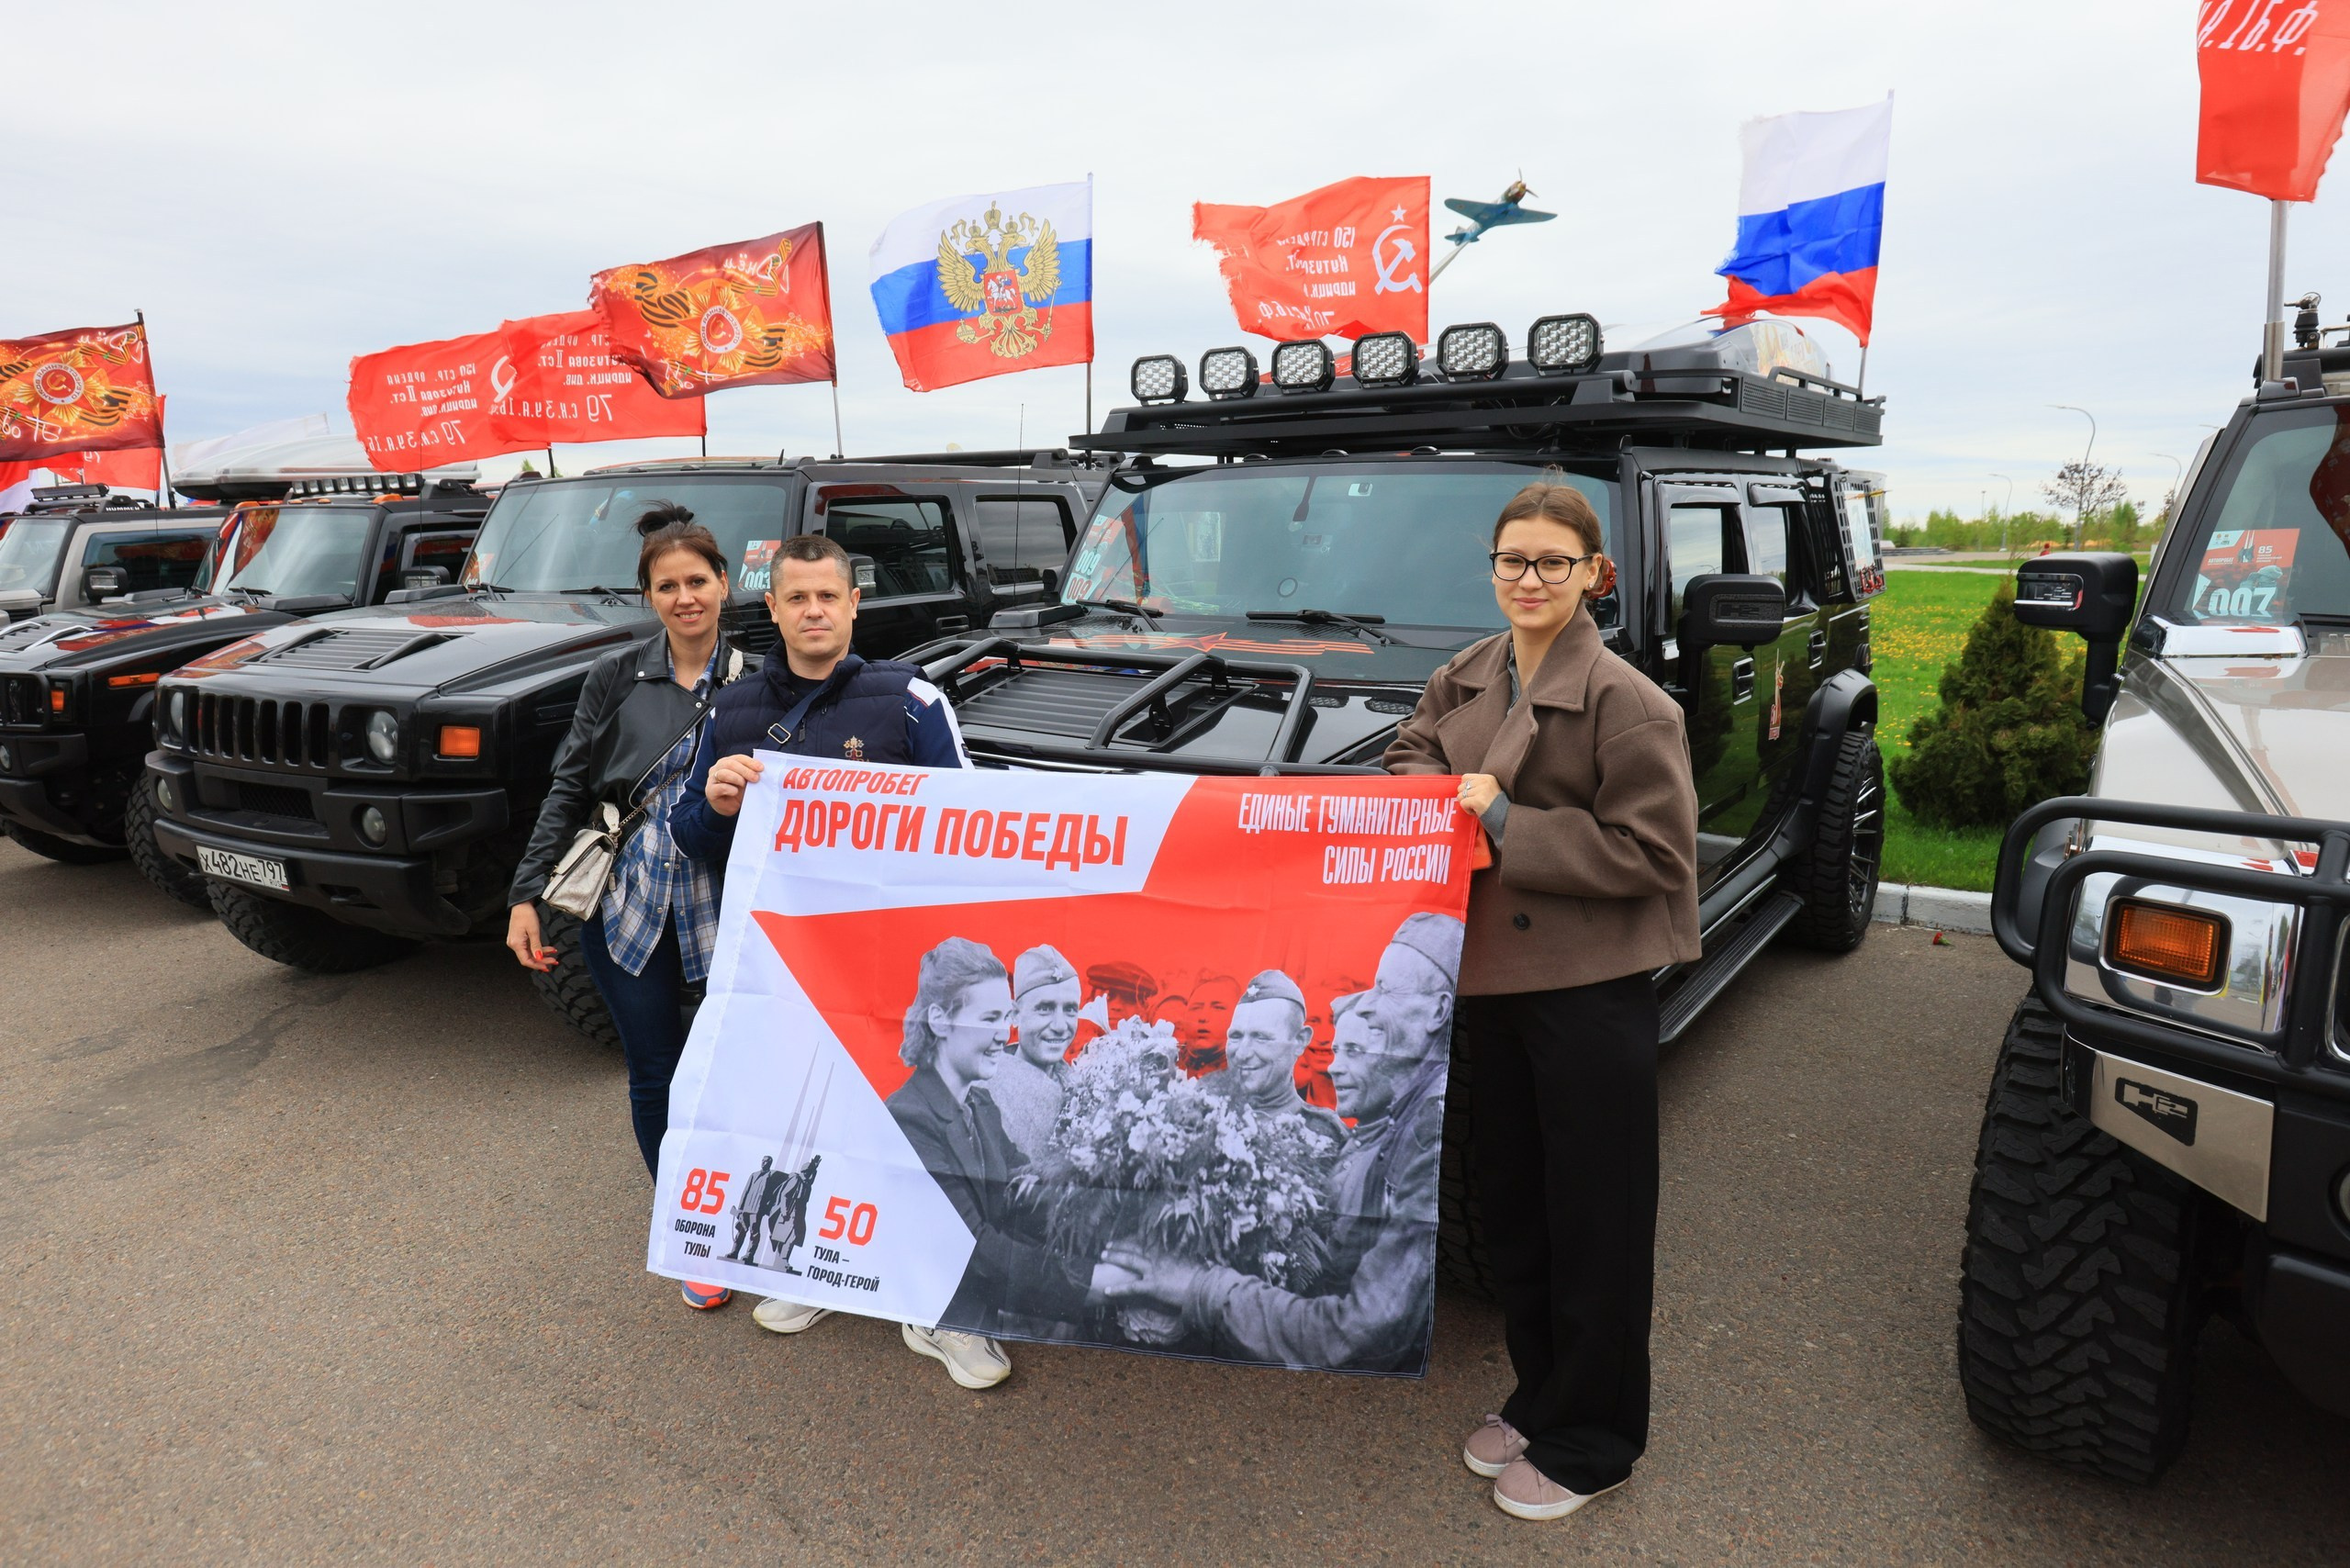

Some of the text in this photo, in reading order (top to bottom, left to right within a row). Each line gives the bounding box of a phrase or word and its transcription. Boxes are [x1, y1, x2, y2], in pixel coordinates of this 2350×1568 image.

[1075, 549, 1102, 576] 009
[1067, 577, 1092, 599] 009
[2208, 587, 2277, 611] 007
[783, 767, 929, 796] АВТОПРОБЕГ
[1238, 792, 1458, 835] ЕДИНЫЕ ГУМАНИТАРНЫЕ
[774, 800, 1128, 872] ДОРОГИ ПОБЕДЫ
[1323, 844, 1451, 885] СИЛЫ РОССИИ
[680, 1168, 731, 1215] 85
[675, 1218, 716, 1238] ОБОРОНА
[818, 1195, 878, 1247] 50
[684, 1241, 711, 1258] ТУЛЫ
[813, 1245, 840, 1264] ТУЛА
[807, 1265, 880, 1293] ГОРОД-ГЕРОЙ
